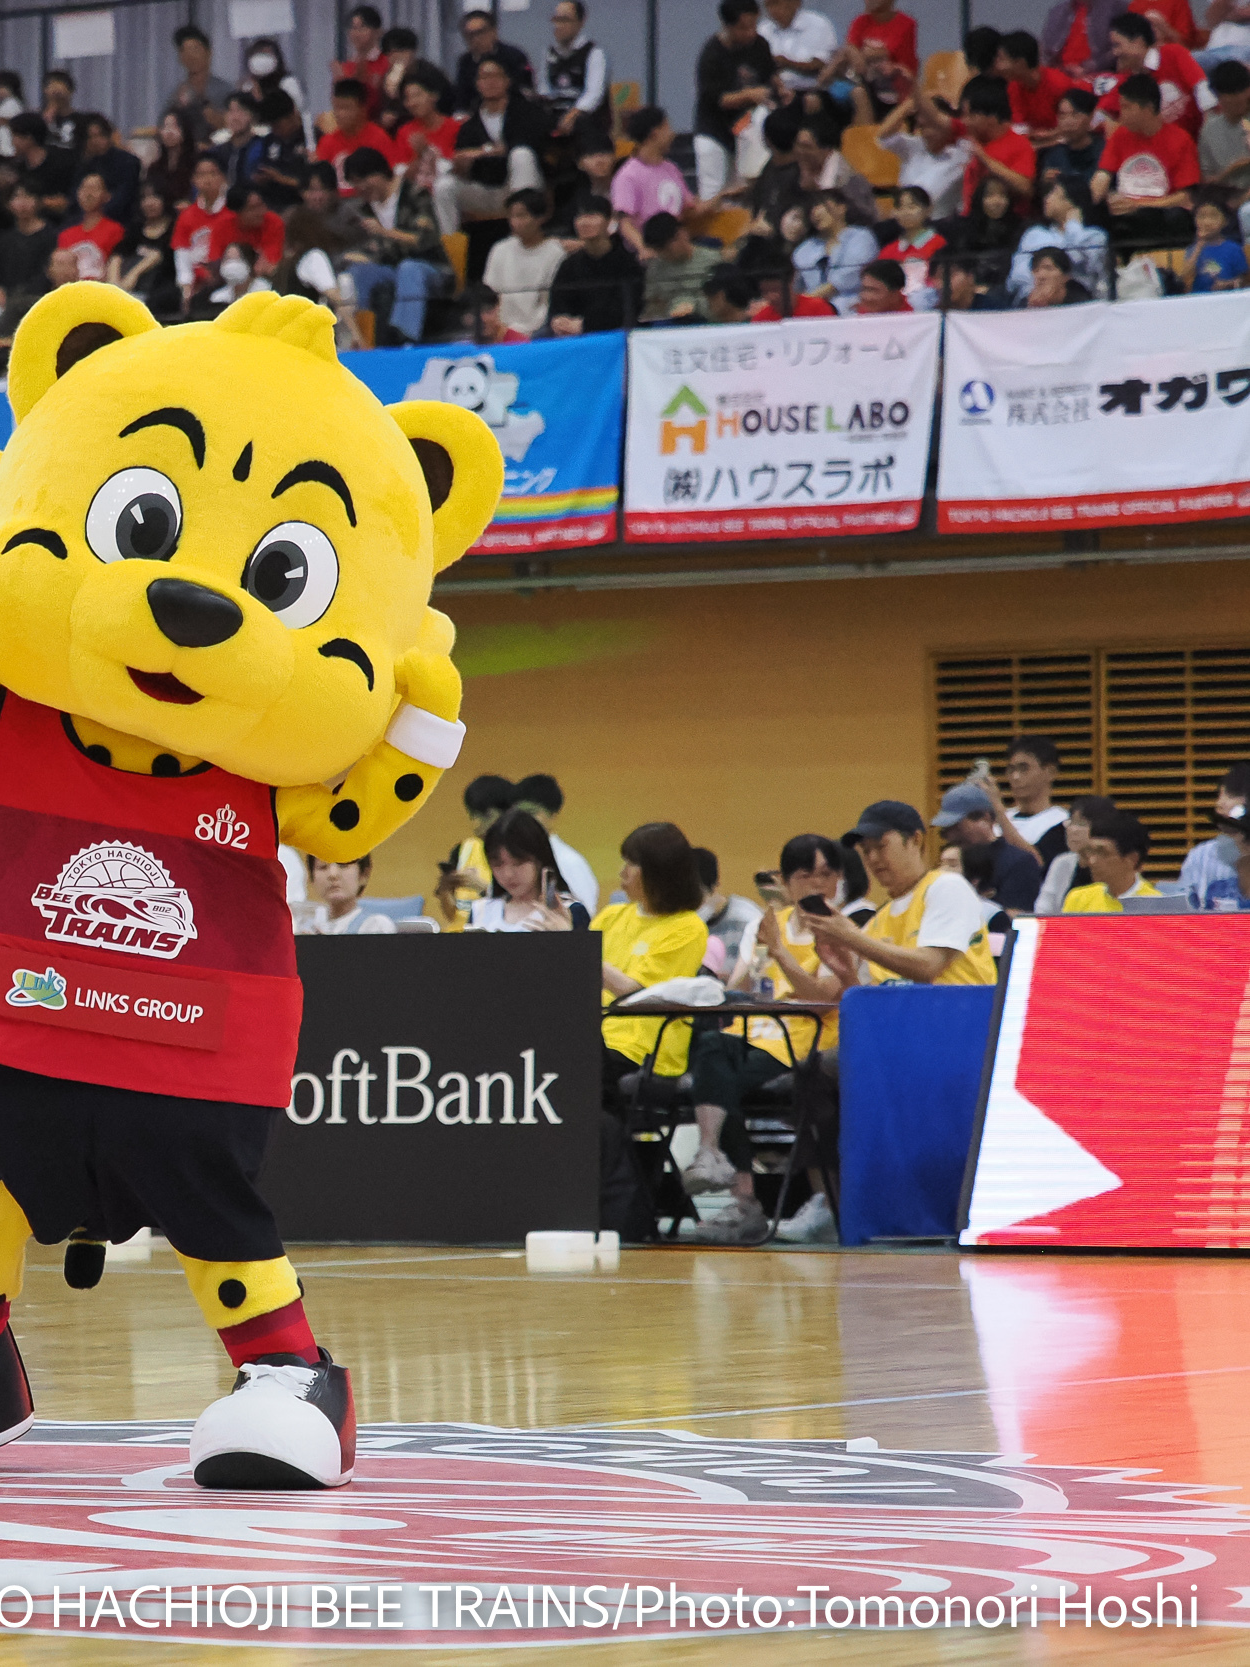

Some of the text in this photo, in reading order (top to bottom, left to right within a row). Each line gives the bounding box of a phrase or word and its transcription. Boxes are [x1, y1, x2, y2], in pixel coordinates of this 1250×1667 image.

[194, 812, 250, 851] 802
[67, 849, 161, 881] TOKYO HACHIOJI
[34, 886, 74, 904] BEE
[152, 904, 172, 914] 802
[42, 903, 184, 952] TRAINS
[74, 987, 204, 1024] LINKS GROUP
[285, 1046, 563, 1125] oftBank
